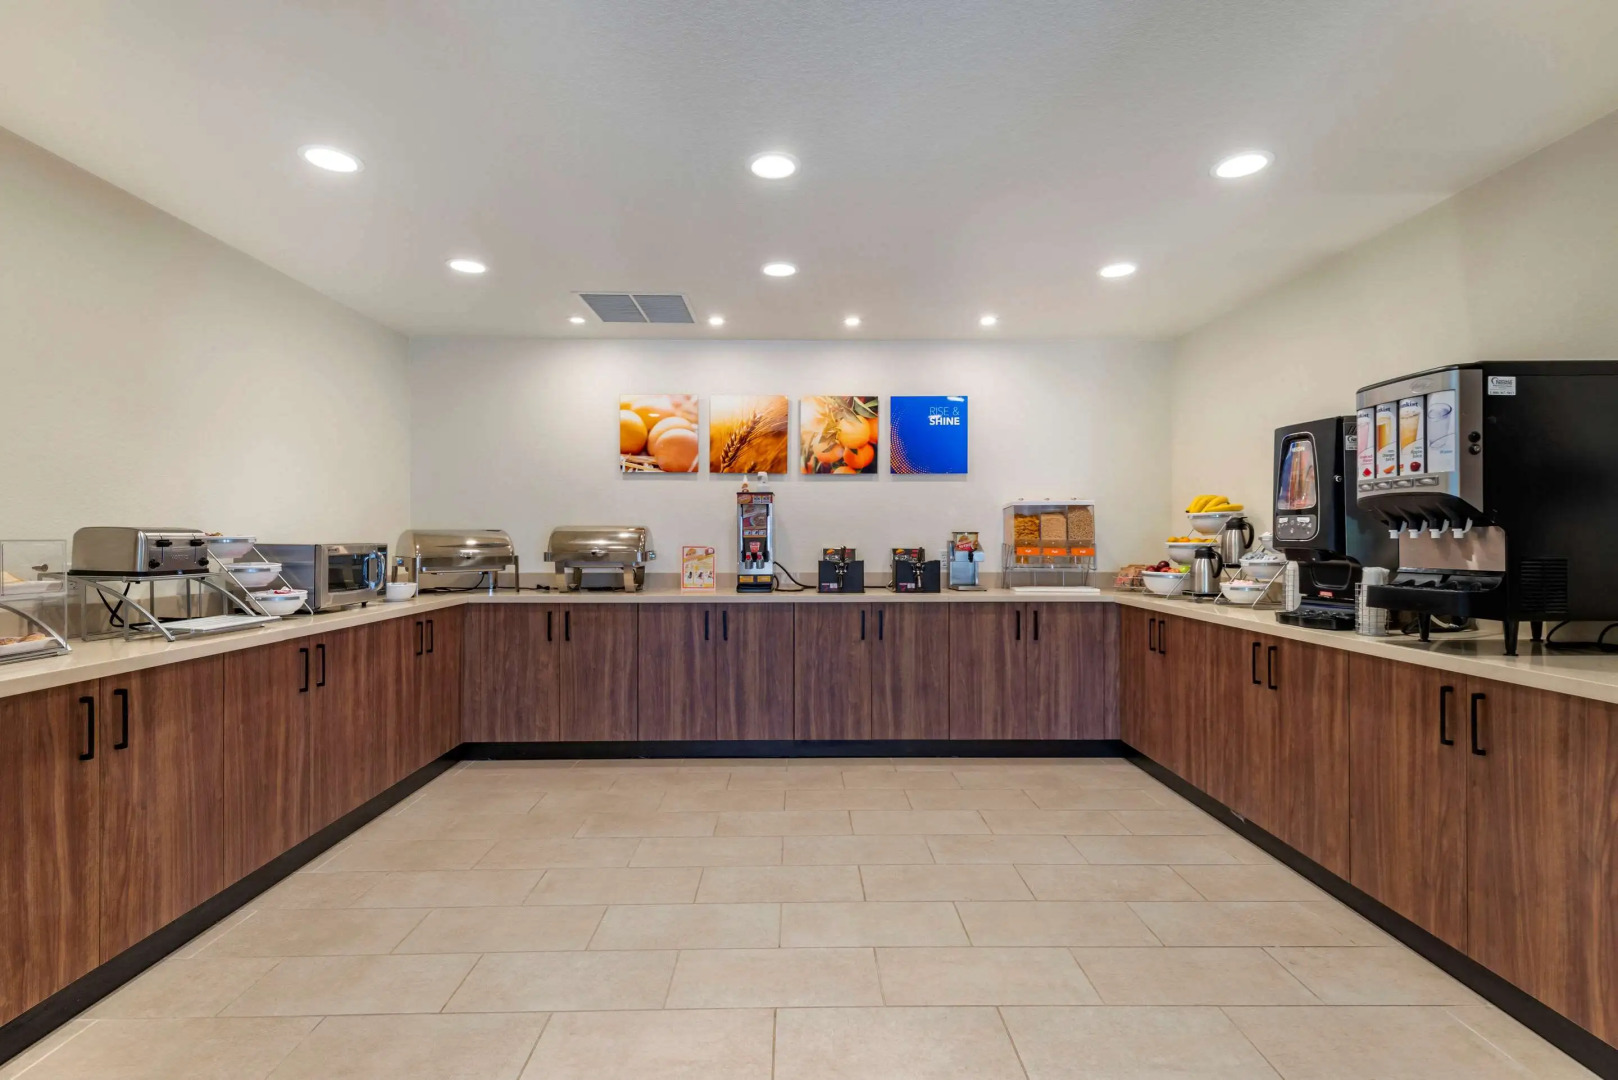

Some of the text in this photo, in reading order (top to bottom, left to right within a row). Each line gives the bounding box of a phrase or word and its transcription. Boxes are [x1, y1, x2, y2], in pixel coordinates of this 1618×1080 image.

[929, 406, 960, 416] RISE &
[929, 416, 960, 425] SHINE
